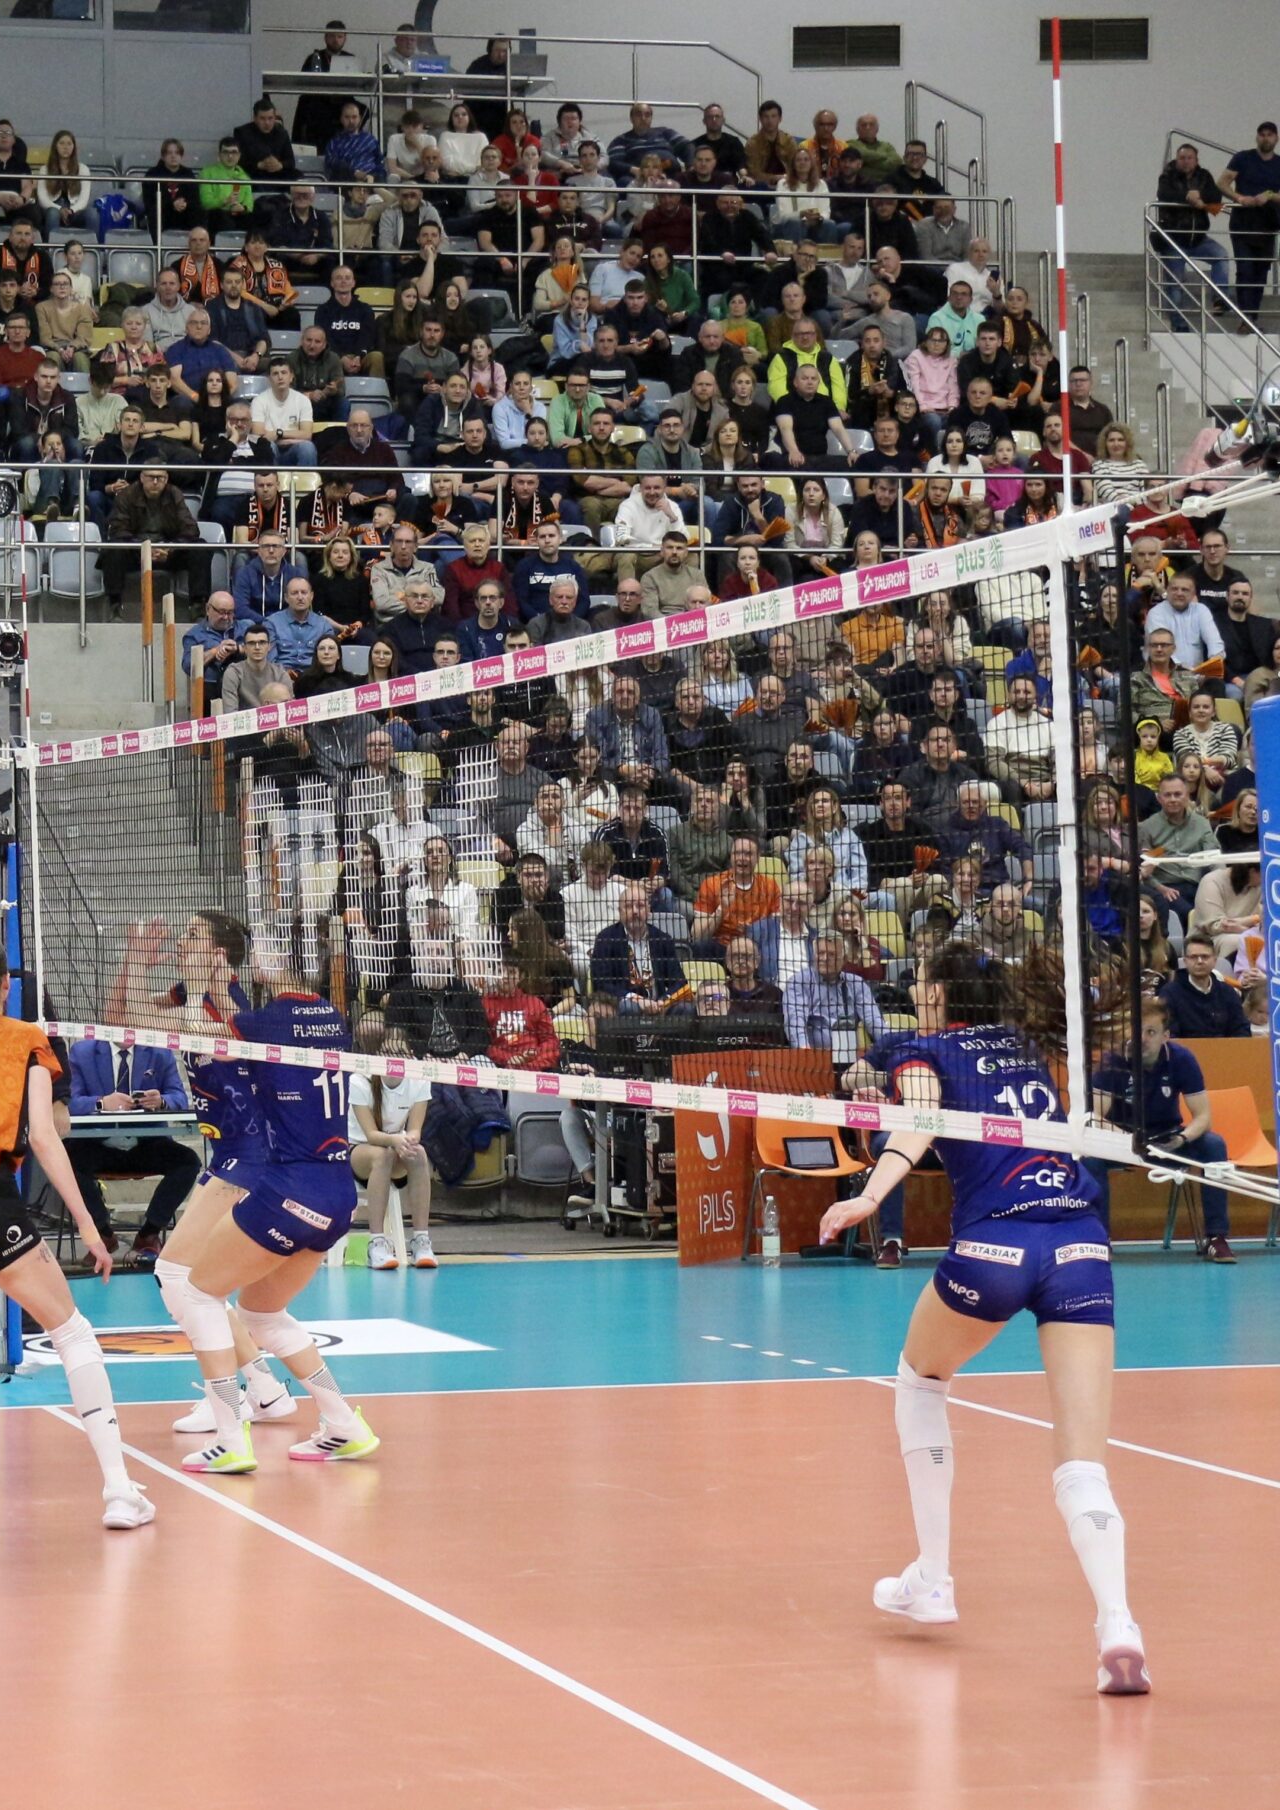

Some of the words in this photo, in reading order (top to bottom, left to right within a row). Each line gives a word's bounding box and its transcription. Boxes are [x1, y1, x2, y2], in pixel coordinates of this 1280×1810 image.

[1078, 519, 1106, 541] netex
[954, 543, 986, 580] plus
[873, 569, 906, 591] TAURON
[920, 562, 939, 580] LIGA
[808, 585, 838, 606] TAURON
[715, 611, 731, 628] LIGA
[742, 601, 767, 630] plus
[678, 617, 704, 635] TAURON
[626, 630, 652, 648] TAURON
[574, 640, 595, 666] plus
[481, 663, 504, 680] TAURON
[523, 654, 545, 671] TAURON
[396, 683, 416, 698] TAURON
[312, 1070, 345, 1120] 11
[786, 1102, 804, 1119] plus
[855, 1109, 880, 1122] TAURON
[913, 1113, 934, 1132] plus
[993, 1124, 1020, 1140] TAURON
[698, 1190, 736, 1235] PLS
[970, 1245, 1019, 1260] STASIAK
